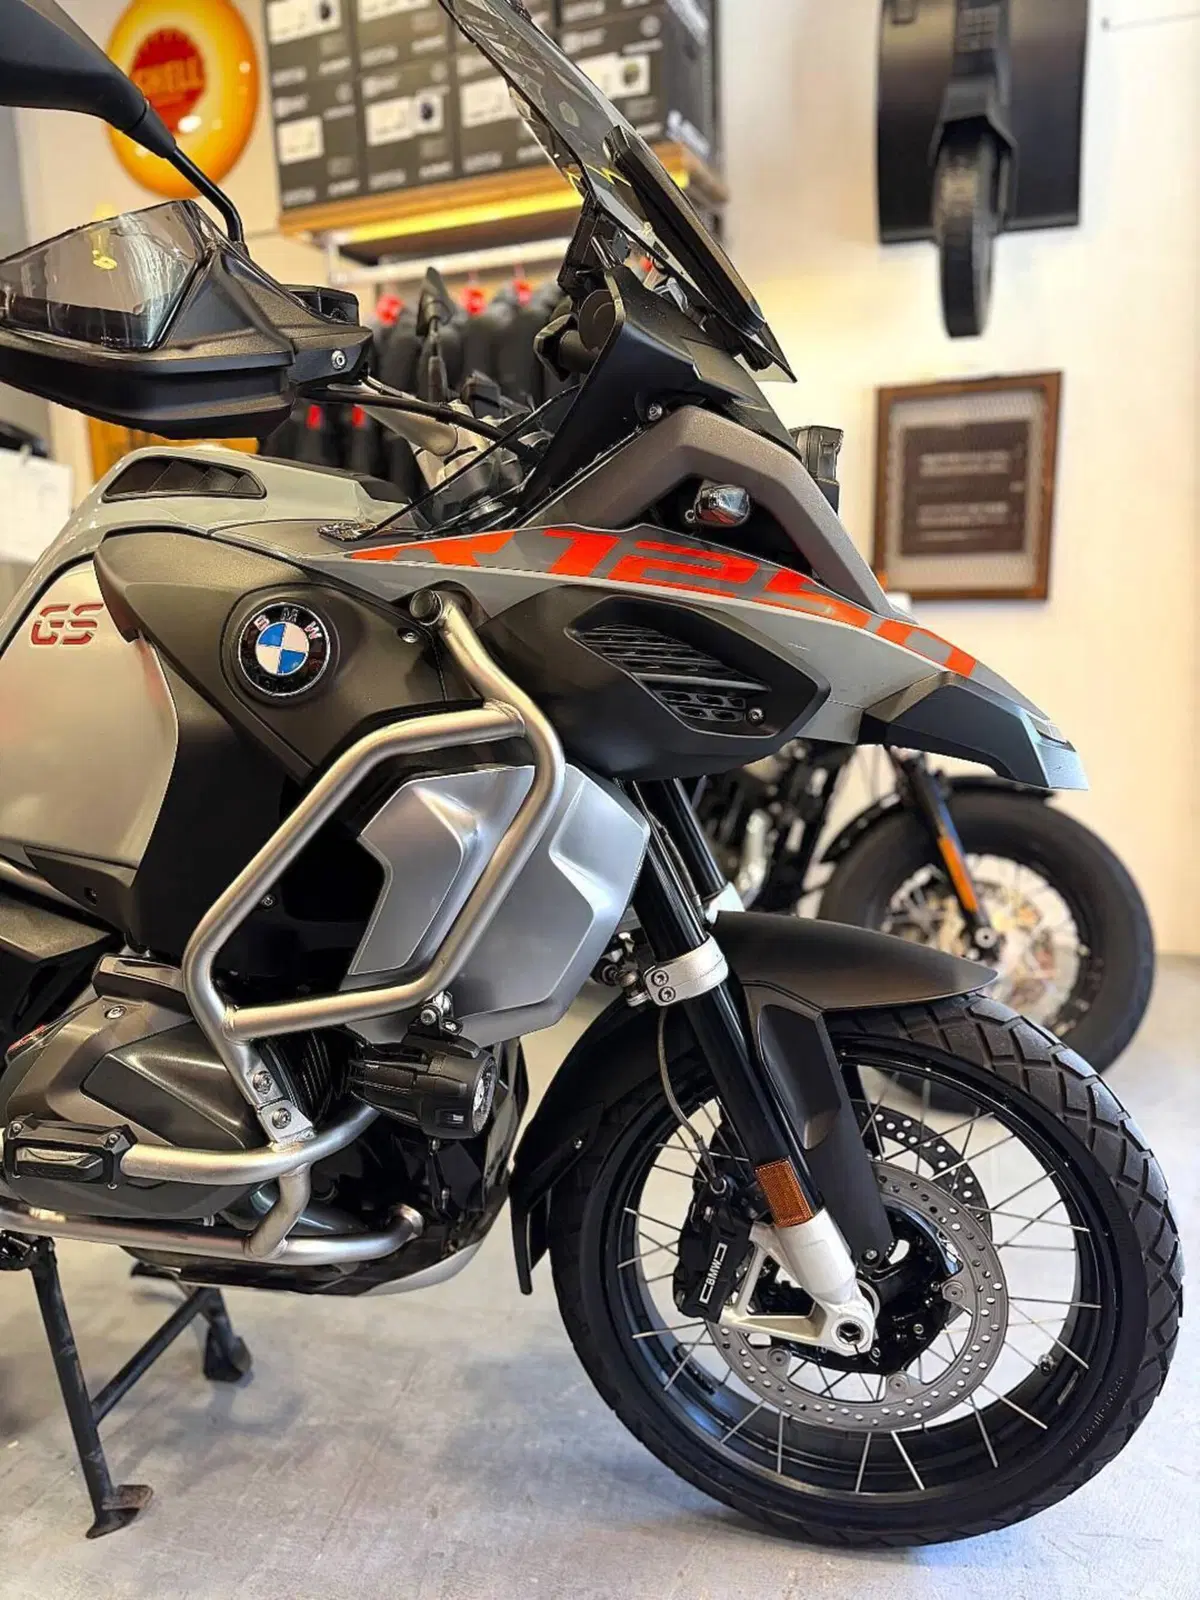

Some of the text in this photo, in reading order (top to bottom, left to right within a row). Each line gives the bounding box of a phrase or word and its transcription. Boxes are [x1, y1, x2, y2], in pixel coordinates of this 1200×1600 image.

[31, 603, 103, 646] GS
[253, 607, 323, 640] BMW
[705, 1258, 722, 1286] BMW
